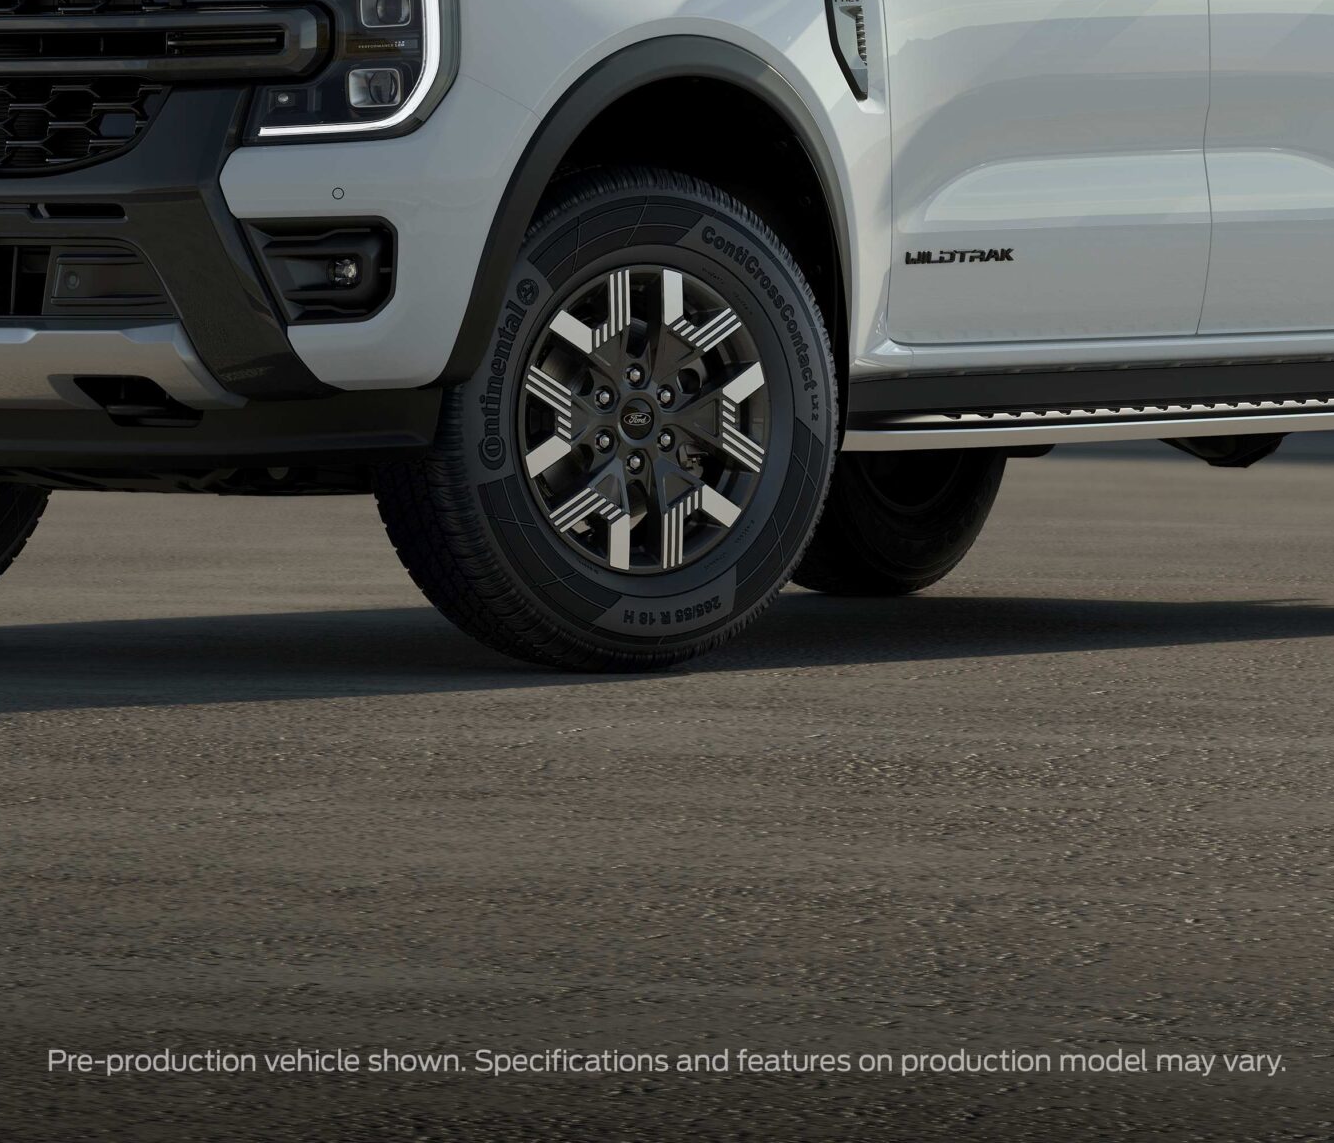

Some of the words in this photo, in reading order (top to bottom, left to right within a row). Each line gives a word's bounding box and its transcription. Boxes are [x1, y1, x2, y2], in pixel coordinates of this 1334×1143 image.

[701, 225, 818, 392] ContiCrossContact
[904, 247, 1015, 265] WILDTRAK
[478, 299, 528, 470] Continental
